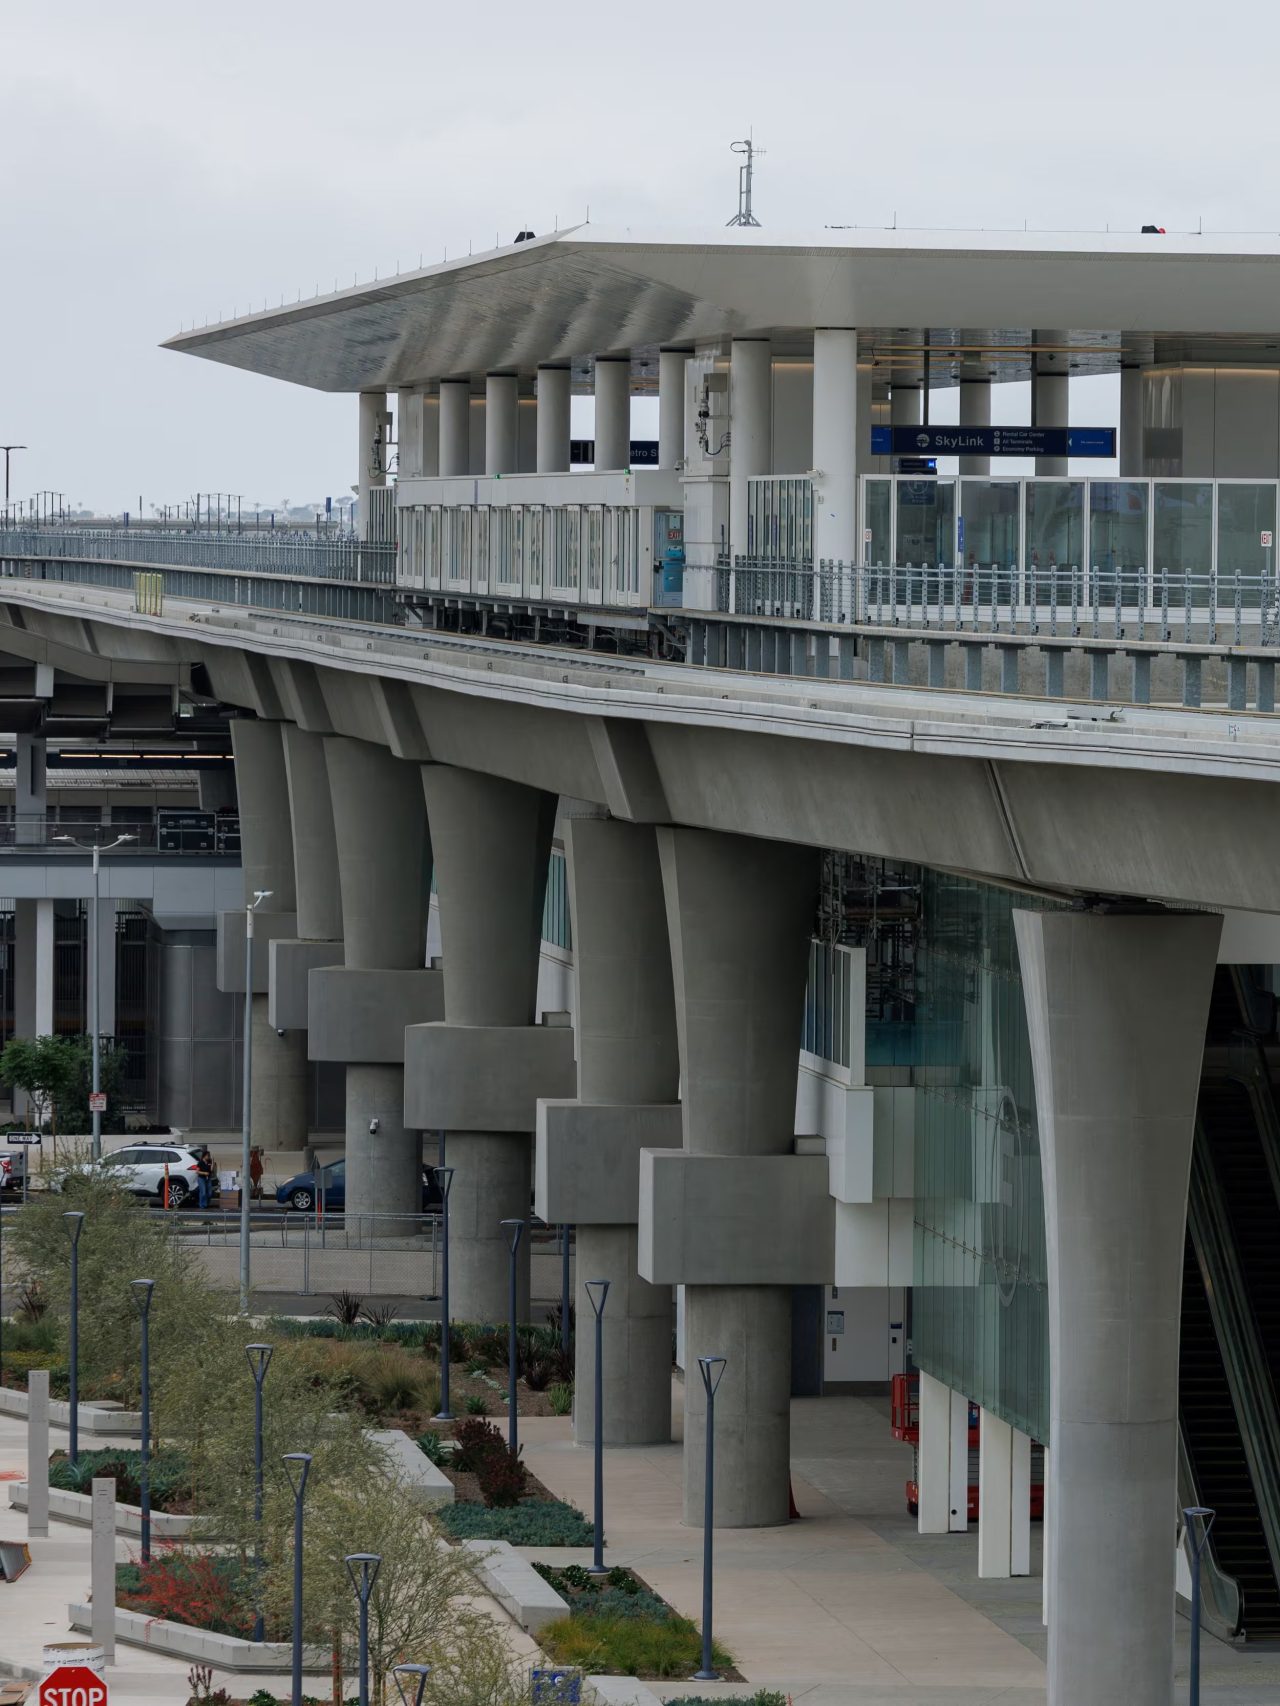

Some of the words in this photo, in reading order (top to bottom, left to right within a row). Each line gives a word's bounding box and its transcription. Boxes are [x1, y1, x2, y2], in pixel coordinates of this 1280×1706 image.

[935, 436, 984, 448] SkyLink
[630, 448, 648, 457] etro
[43, 1687, 105, 1706] STOP
